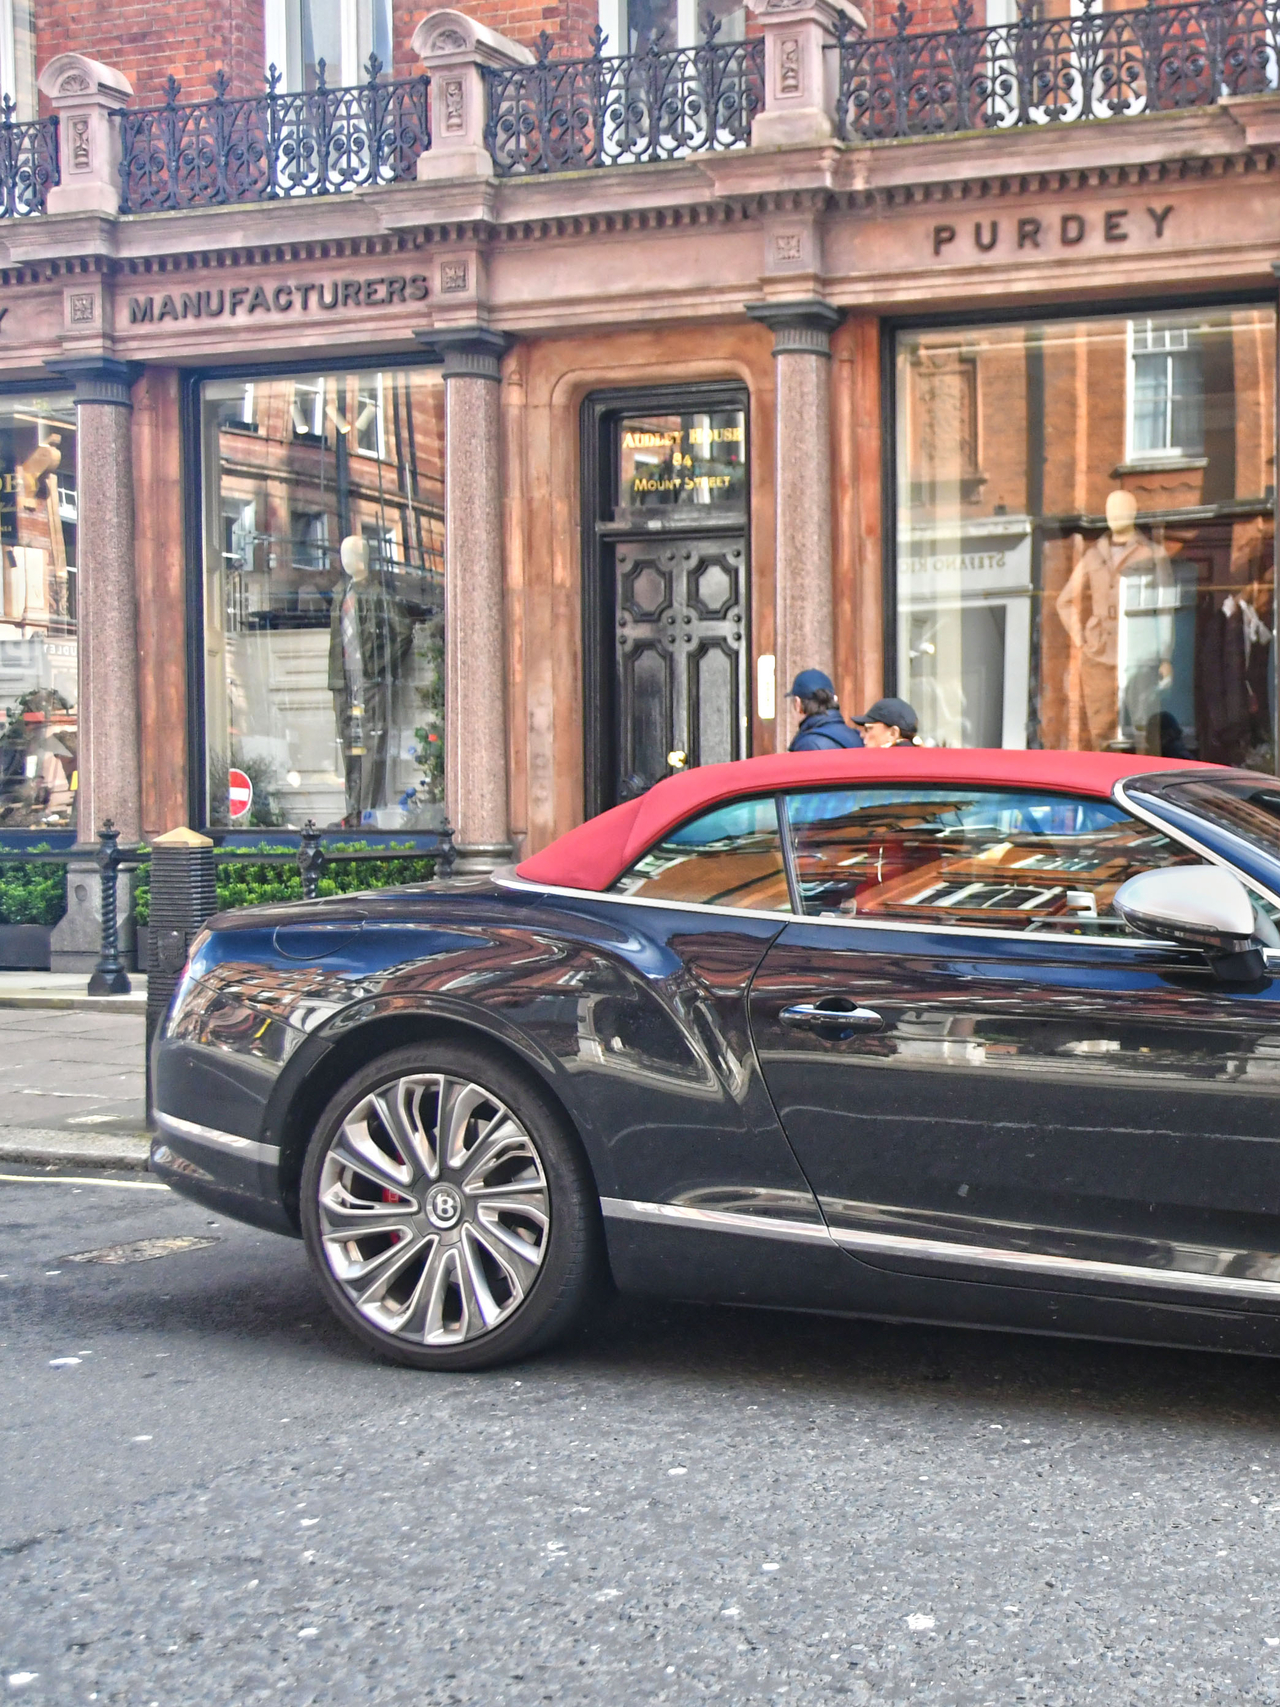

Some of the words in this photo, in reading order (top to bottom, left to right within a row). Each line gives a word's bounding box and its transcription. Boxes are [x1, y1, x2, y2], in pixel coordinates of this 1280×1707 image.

[932, 204, 1175, 256] PURDEY
[128, 274, 430, 324] MANUFACTURERS
[622, 430, 684, 449] AUDLEY
[689, 427, 745, 445] HOUSE
[671, 452, 693, 468] 84
[633, 478, 682, 492] MOUNT
[684, 475, 731, 490] STREET
